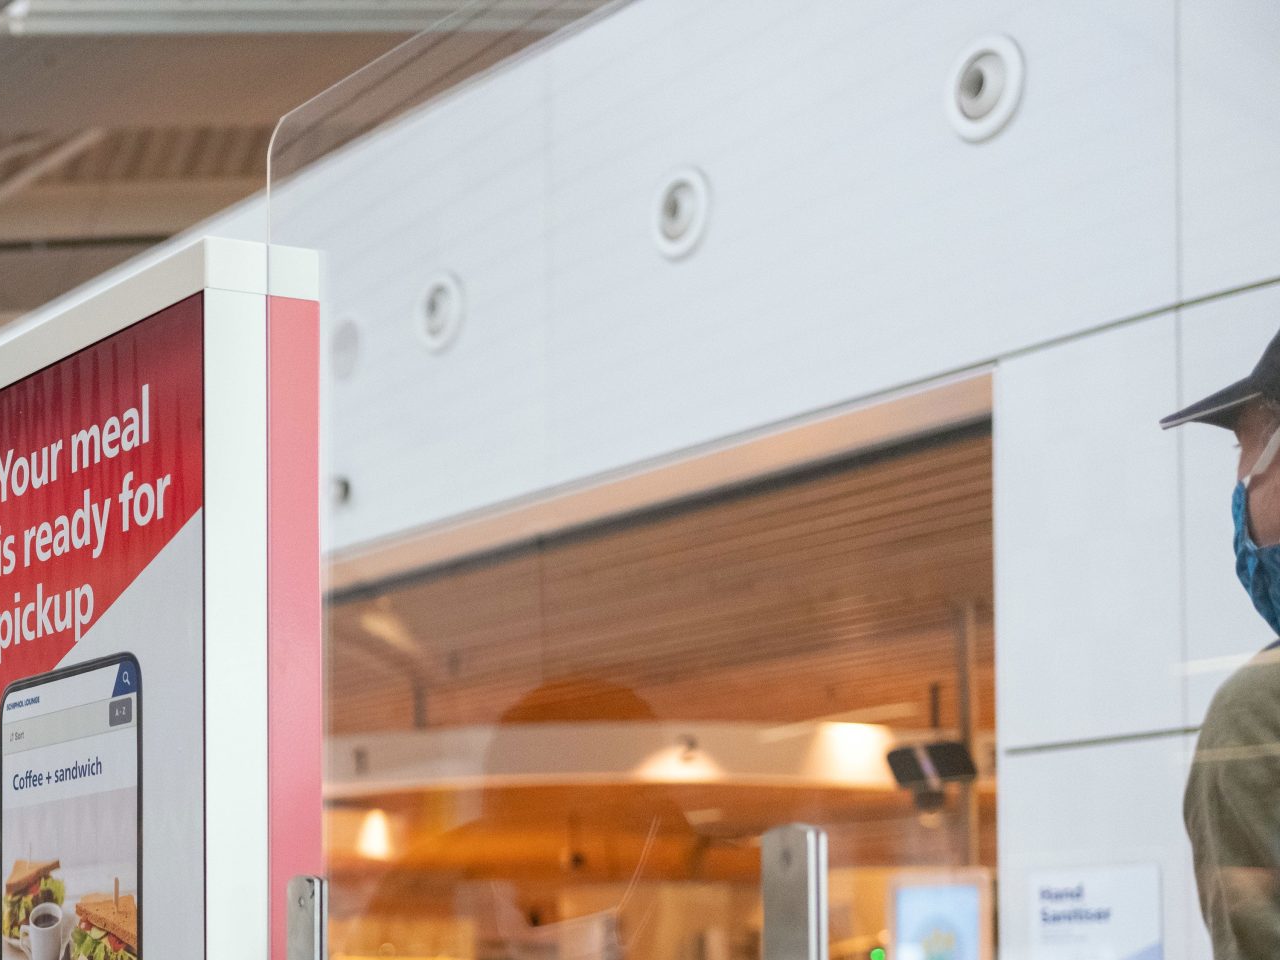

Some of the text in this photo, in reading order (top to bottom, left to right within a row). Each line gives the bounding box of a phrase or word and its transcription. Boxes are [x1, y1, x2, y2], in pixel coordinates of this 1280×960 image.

[71, 383, 150, 474] meal
[23, 488, 111, 567] ready
[118, 471, 171, 532] for
[12, 756, 102, 790] Coffee + sandwich
